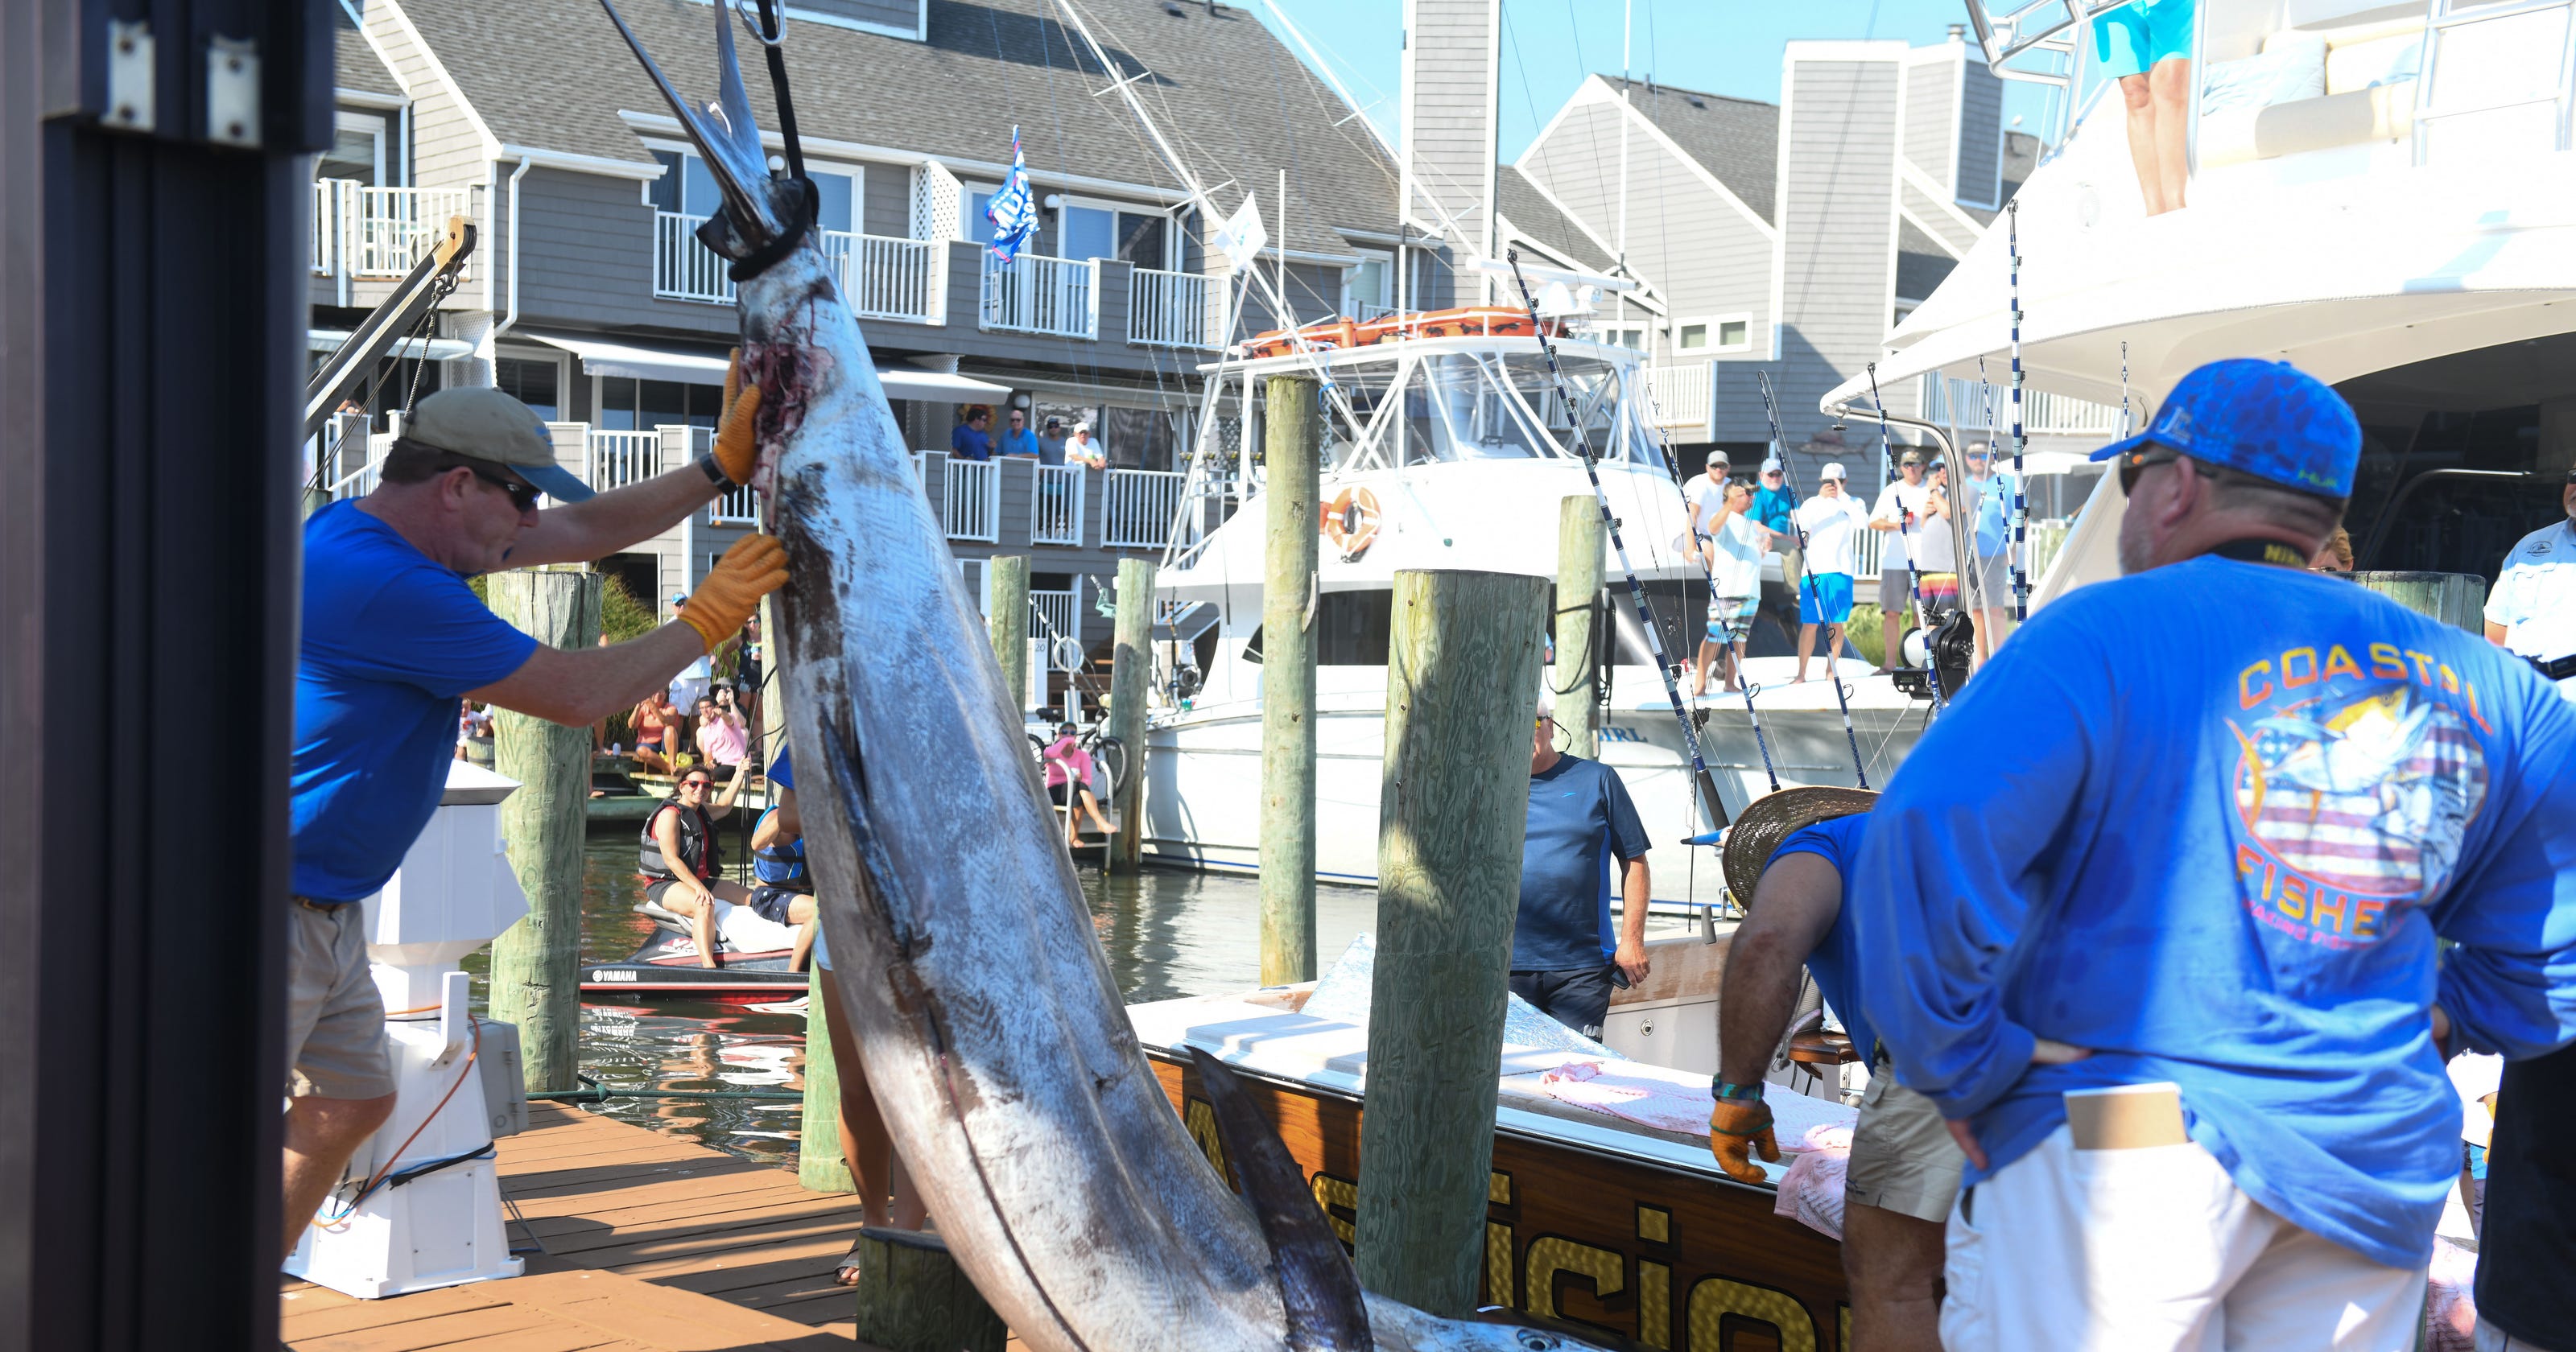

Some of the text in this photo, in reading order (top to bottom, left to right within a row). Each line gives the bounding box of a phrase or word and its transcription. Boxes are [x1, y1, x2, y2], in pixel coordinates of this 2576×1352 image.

[2239, 642, 2493, 736] COASTAL
[1599, 727, 1649, 743] IRL
[2236, 843, 2412, 938] FISHE
[603, 971, 637, 981] YAMAHA
